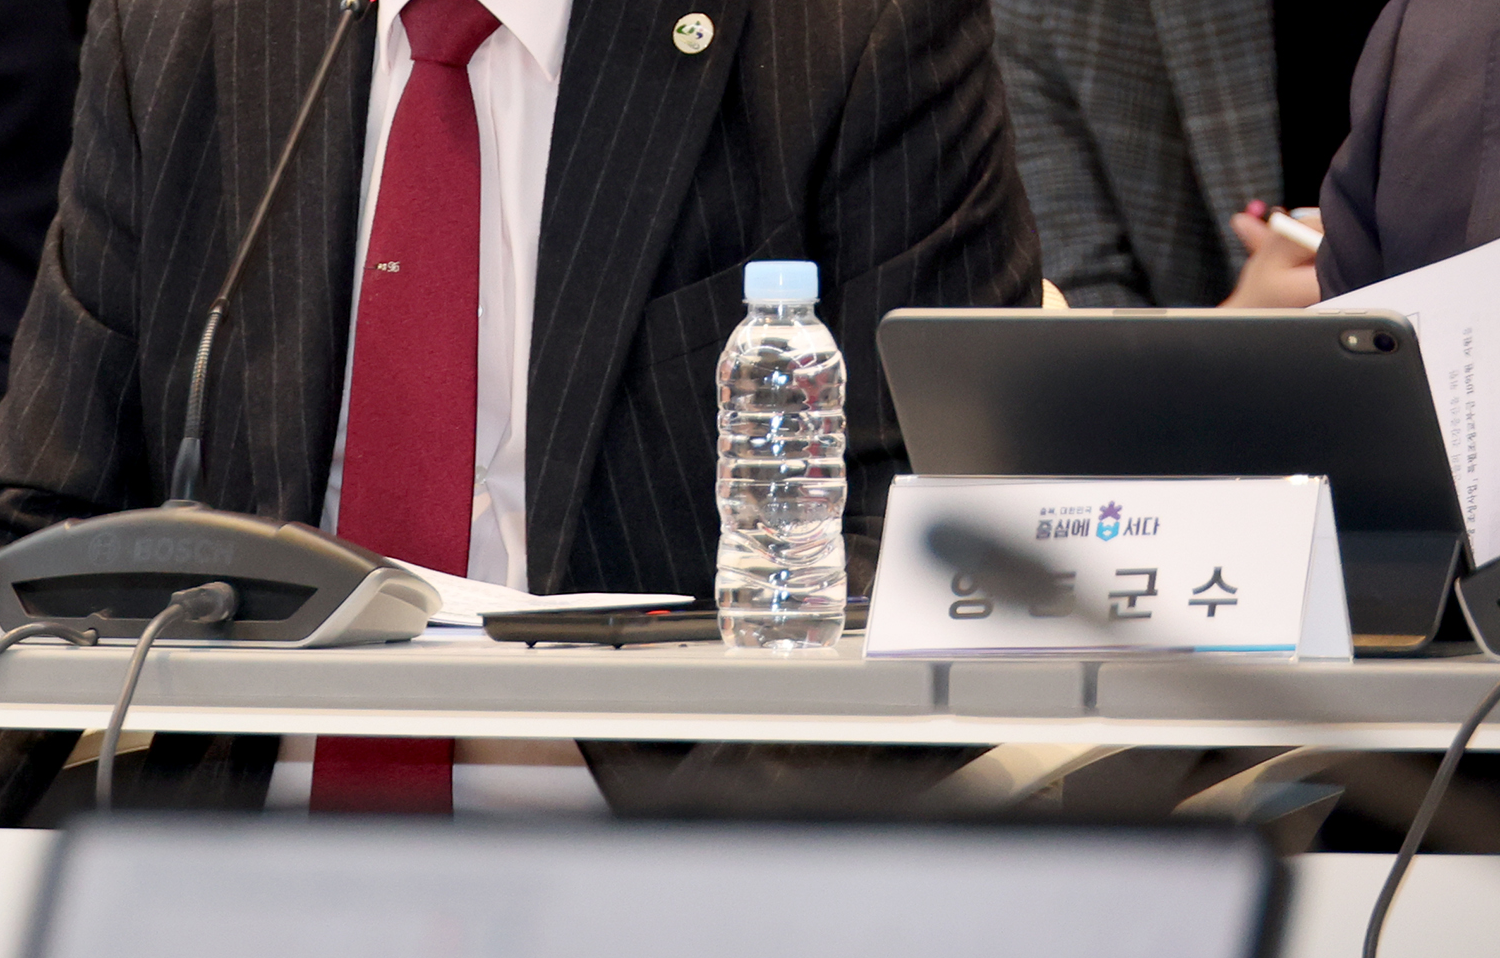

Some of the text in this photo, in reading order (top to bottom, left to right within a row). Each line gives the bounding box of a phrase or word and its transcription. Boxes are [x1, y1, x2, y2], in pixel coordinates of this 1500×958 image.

[1035, 516, 1160, 540] 중심에 서다
[133, 537, 235, 565] BOSCH
